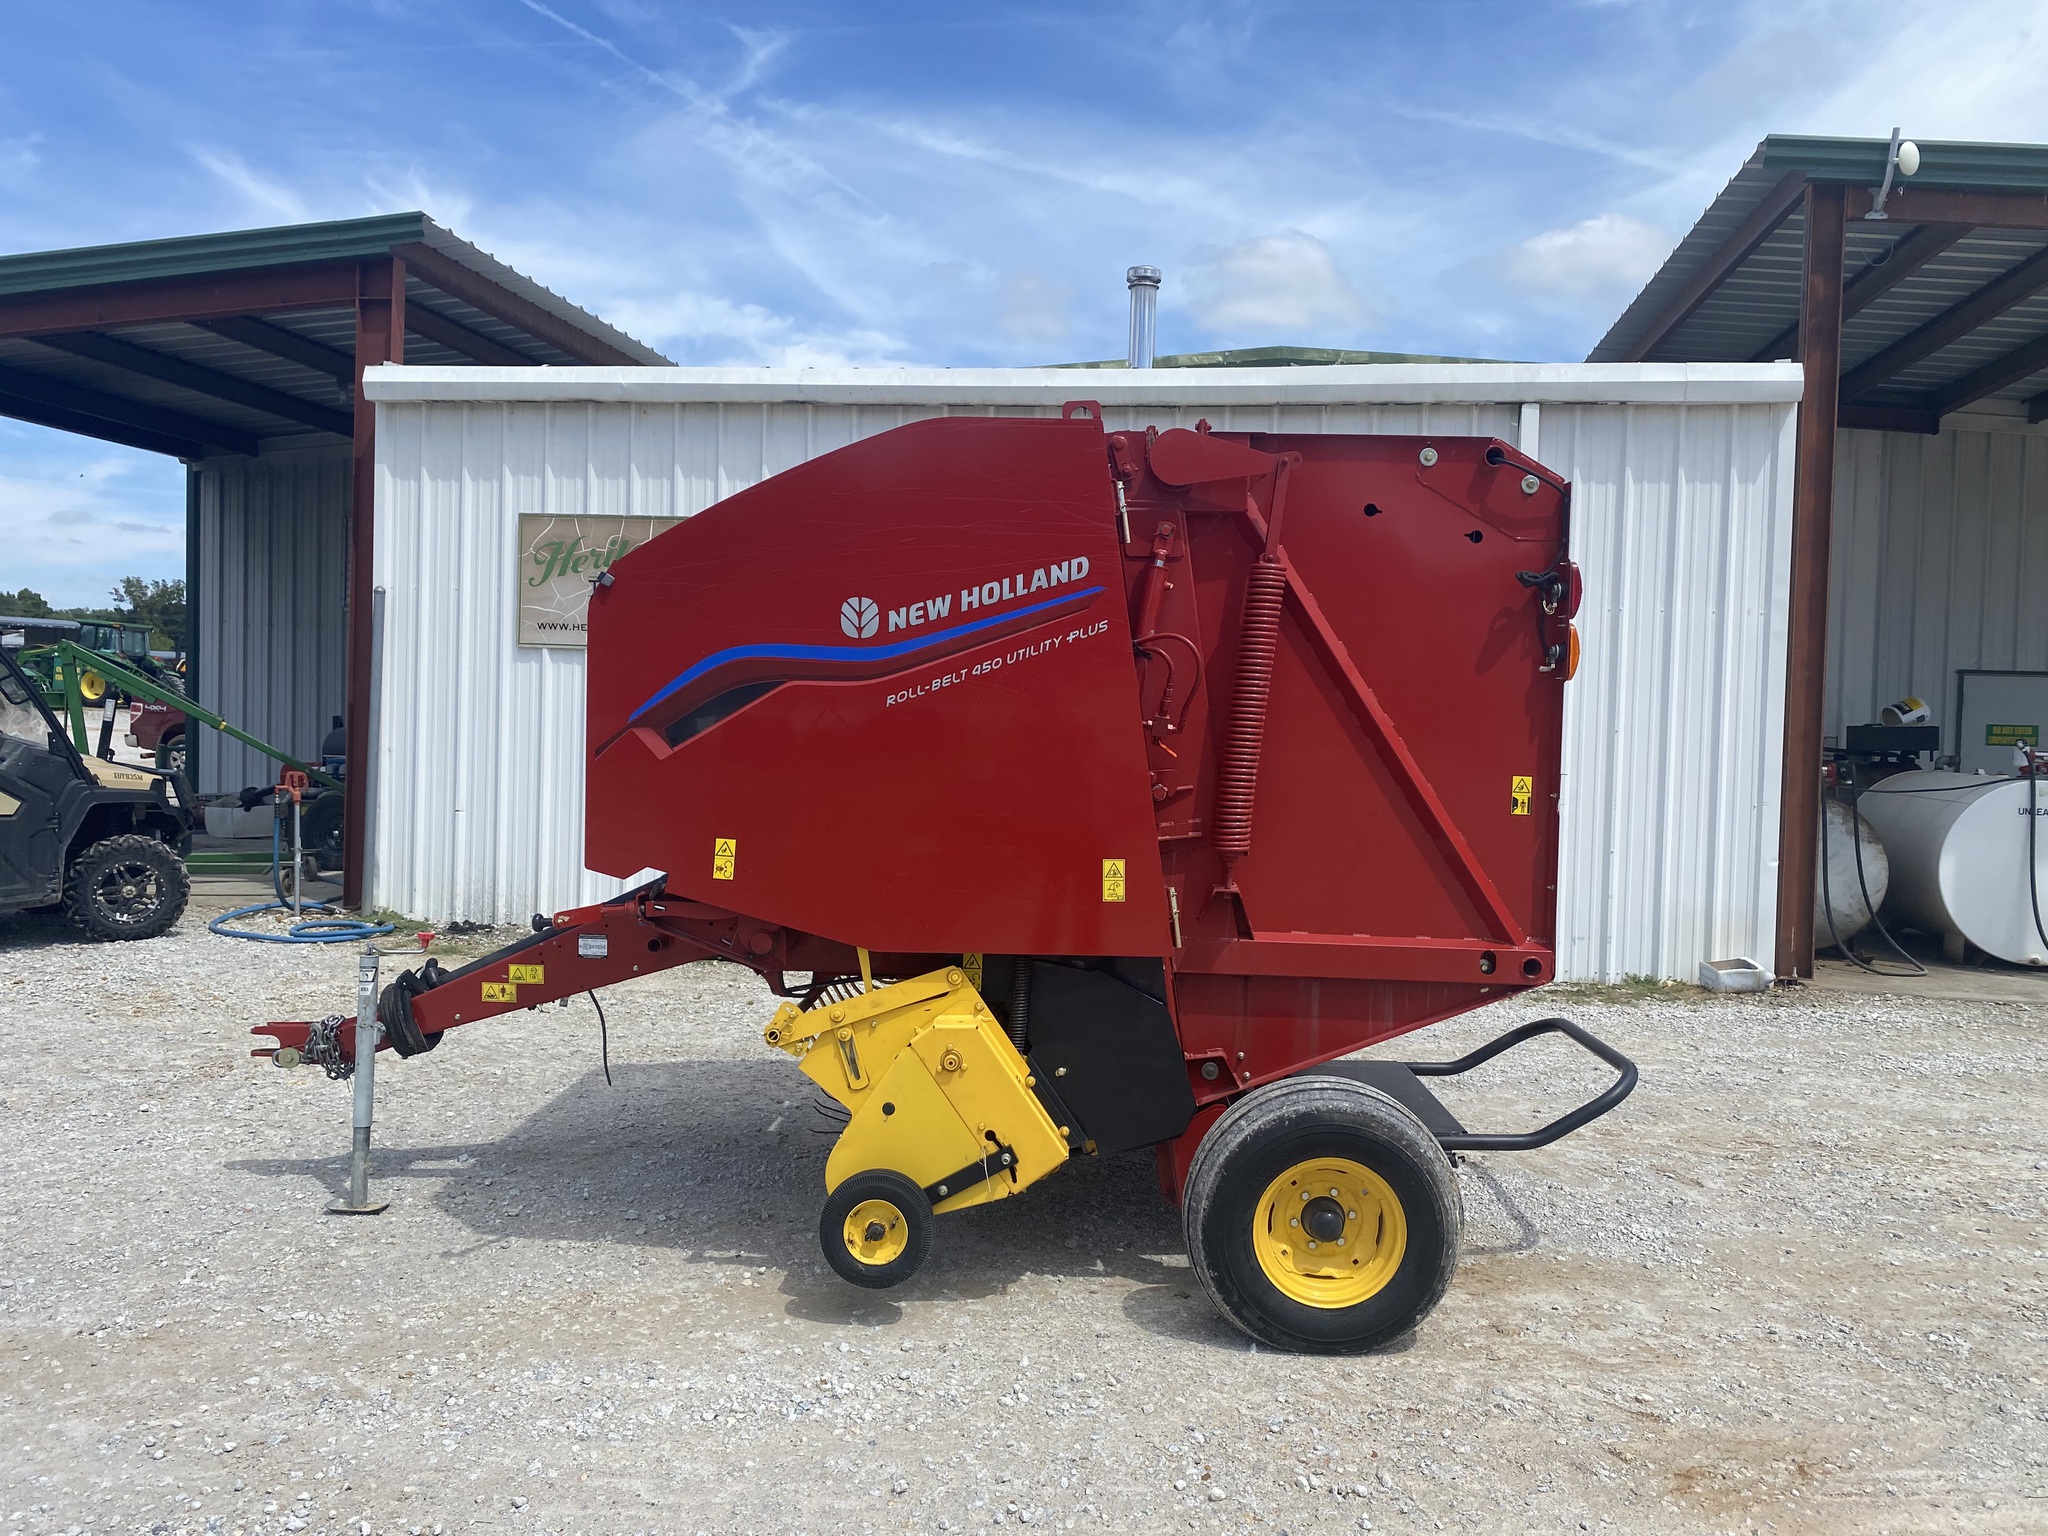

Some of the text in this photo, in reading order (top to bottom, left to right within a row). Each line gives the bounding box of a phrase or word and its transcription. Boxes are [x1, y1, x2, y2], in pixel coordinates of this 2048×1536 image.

[888, 556, 1090, 633] NEW HOLLAND
[885, 668, 968, 708] ROLL-BELT
[971, 657, 1003, 677] 450
[1006, 635, 1065, 665] UTILITY
